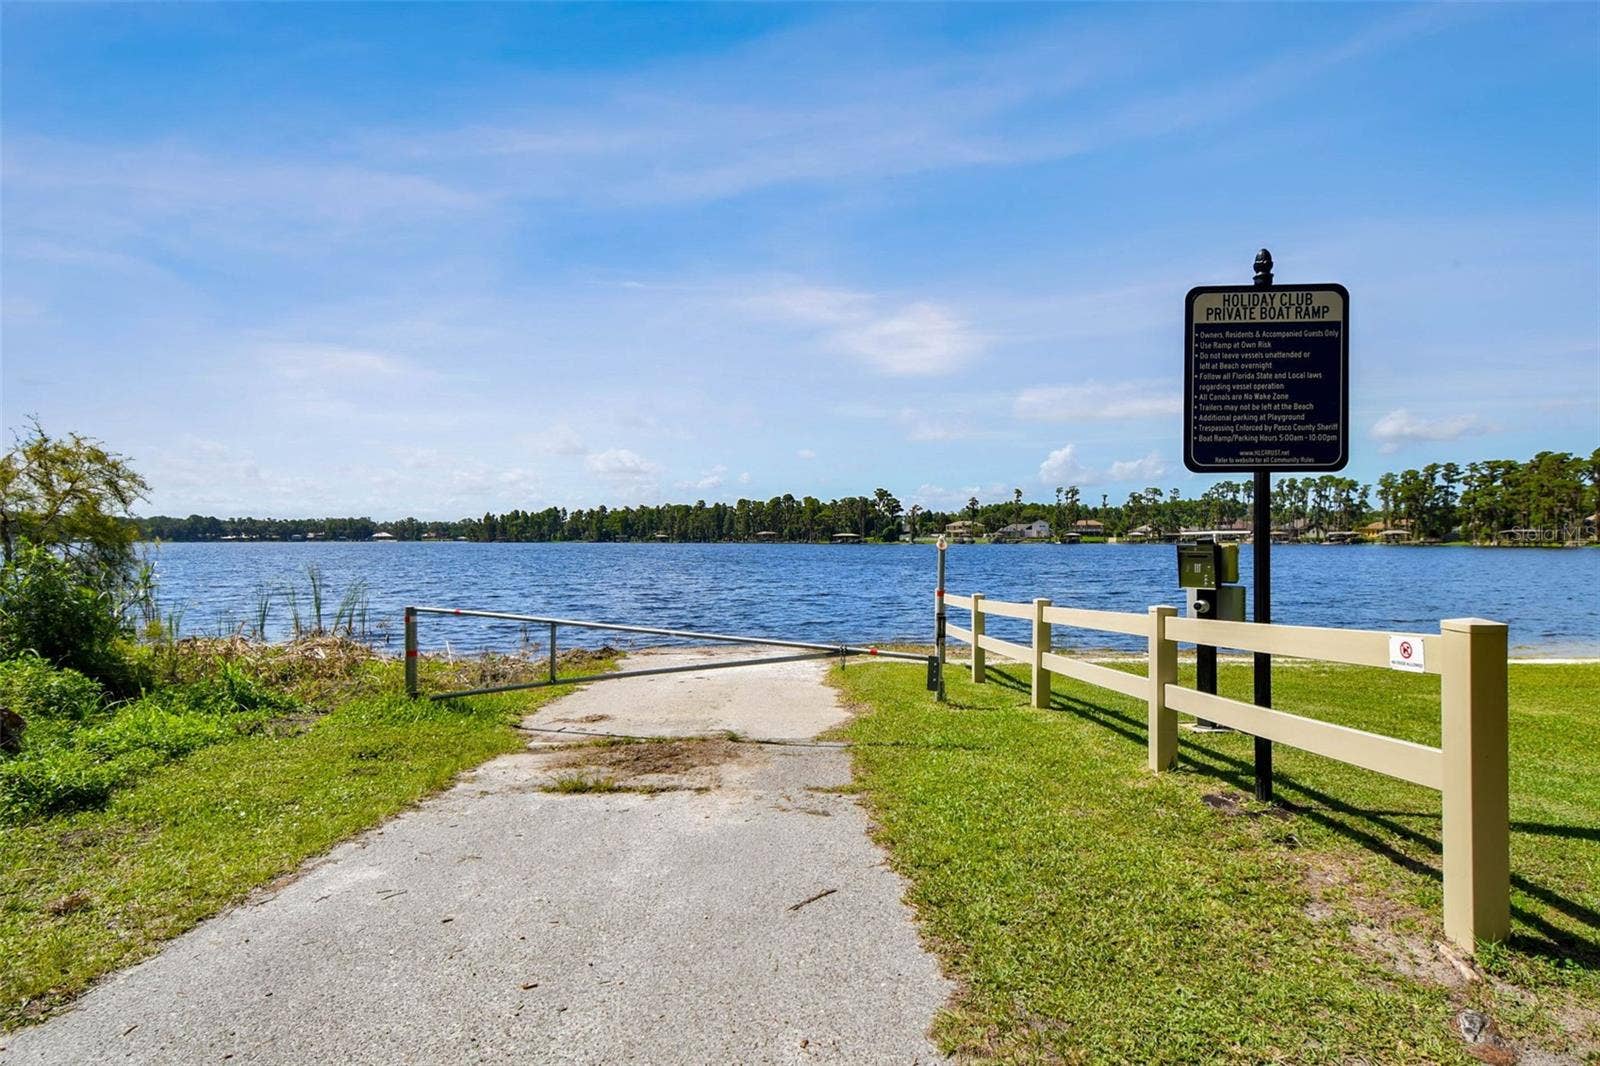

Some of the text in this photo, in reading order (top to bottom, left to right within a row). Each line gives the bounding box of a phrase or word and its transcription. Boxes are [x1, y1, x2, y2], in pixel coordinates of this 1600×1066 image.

[1223, 293, 1312, 307] HOLIDAY CLUB
[1207, 306, 1329, 320] PRIVATE BOAT RAMP
[1214, 342, 1232, 350] Ramp
[1241, 362, 1272, 370] overnight
[1199, 383, 1231, 391] regarding
